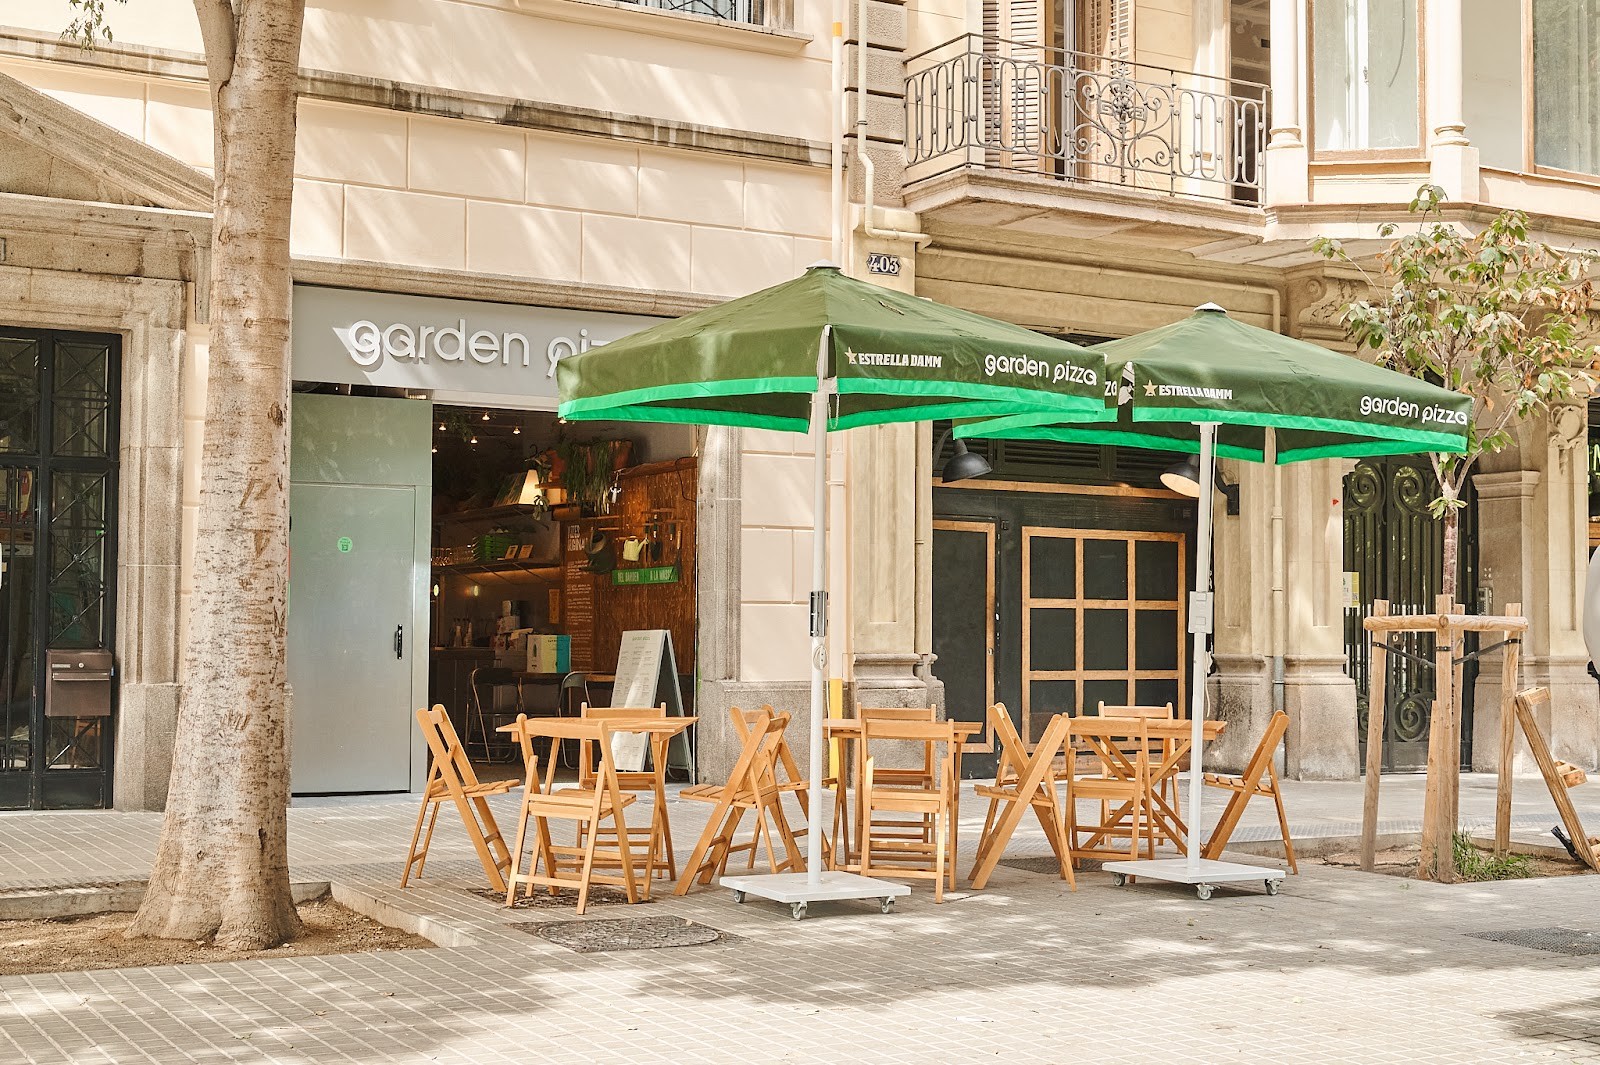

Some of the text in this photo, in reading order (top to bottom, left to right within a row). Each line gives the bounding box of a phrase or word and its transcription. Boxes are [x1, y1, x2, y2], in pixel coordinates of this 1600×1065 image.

[869, 256, 899, 273] 403
[348, 319, 530, 366] garden
[858, 353, 942, 368] ESTRELLA DAMM
[984, 354, 1097, 386] garden pizza
[1158, 384, 1233, 400] ESTRELLA DAMM
[1360, 396, 1468, 426] garden pizza
